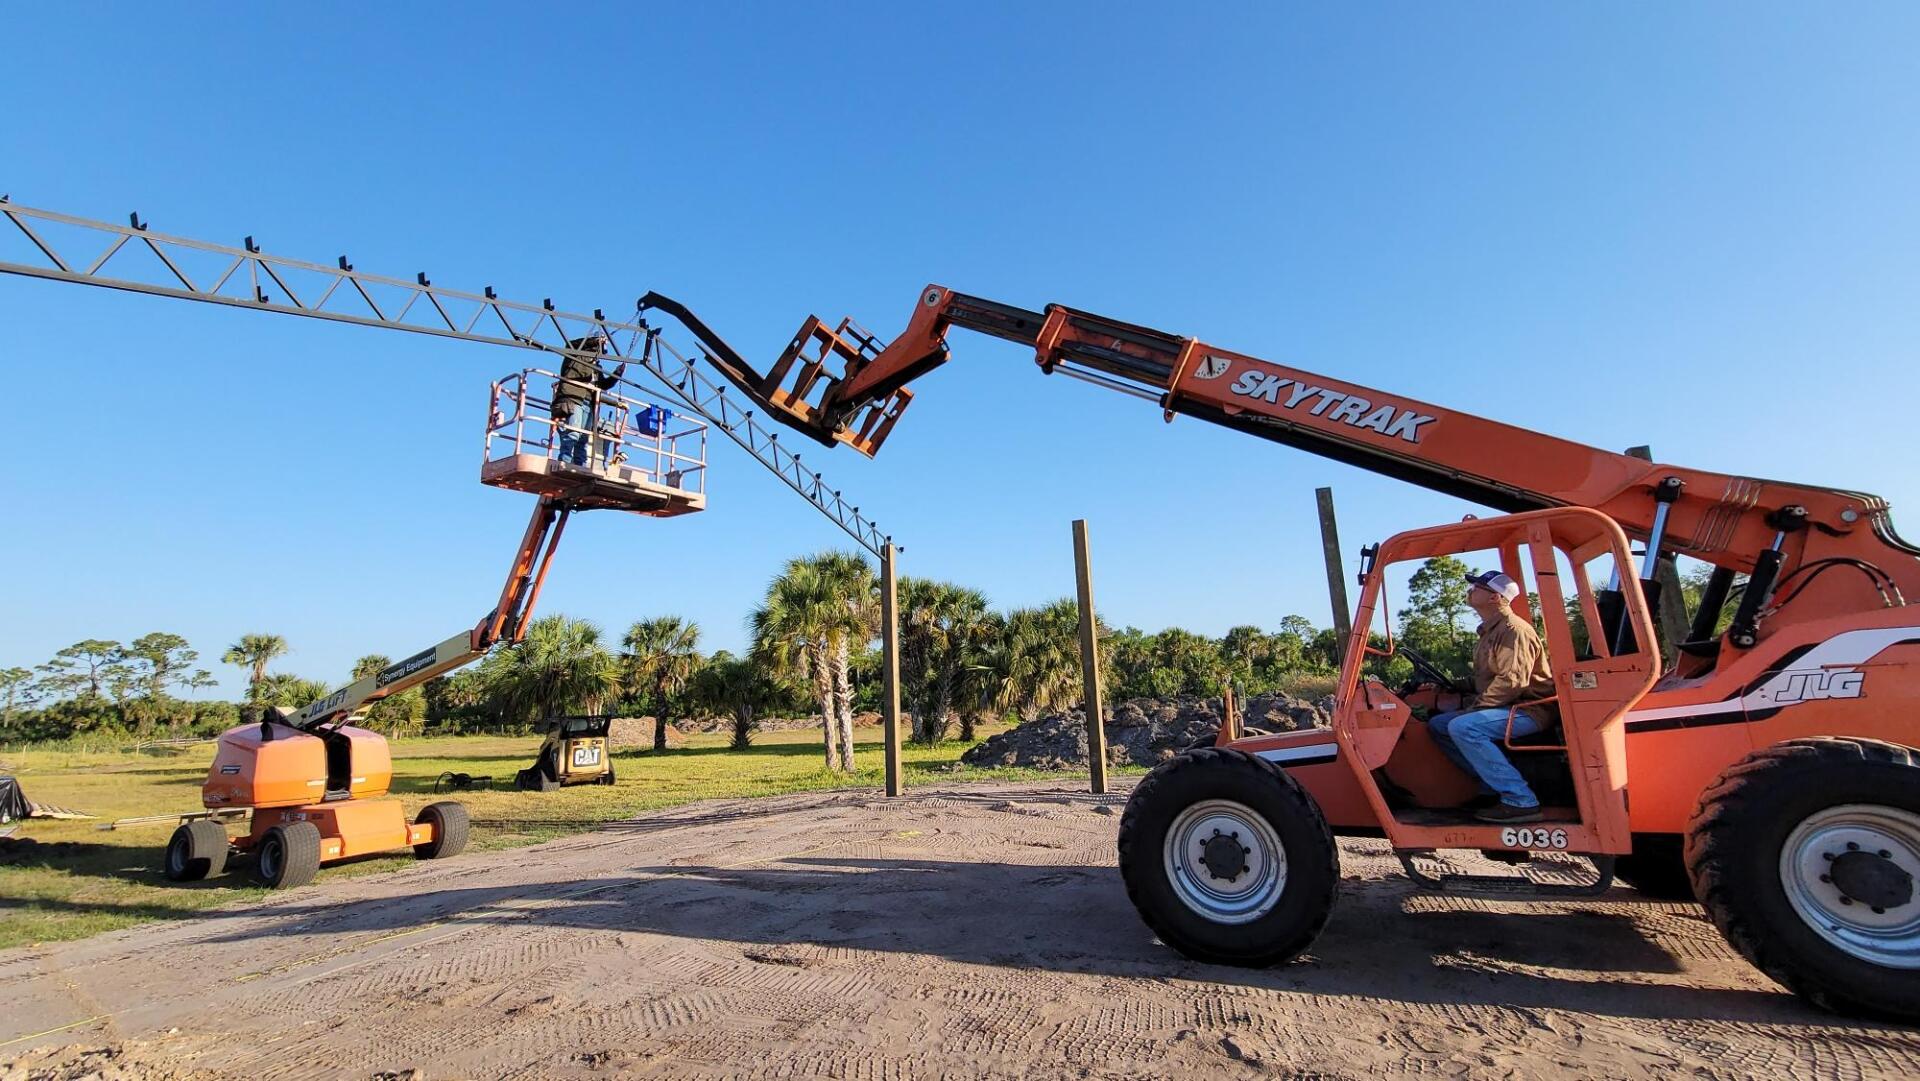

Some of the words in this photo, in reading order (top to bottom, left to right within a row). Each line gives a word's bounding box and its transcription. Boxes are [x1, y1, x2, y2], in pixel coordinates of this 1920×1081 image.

[929, 293, 937, 302] 6
[1231, 370, 1436, 443] SKYTRAK
[384, 667, 405, 683] Synergy
[406, 652, 436, 671] Equipment
[1775, 672, 1865, 702] JLG
[309, 699, 326, 718] JLG
[575, 748, 600, 765] CAT
[1502, 827, 1568, 849] 6036
